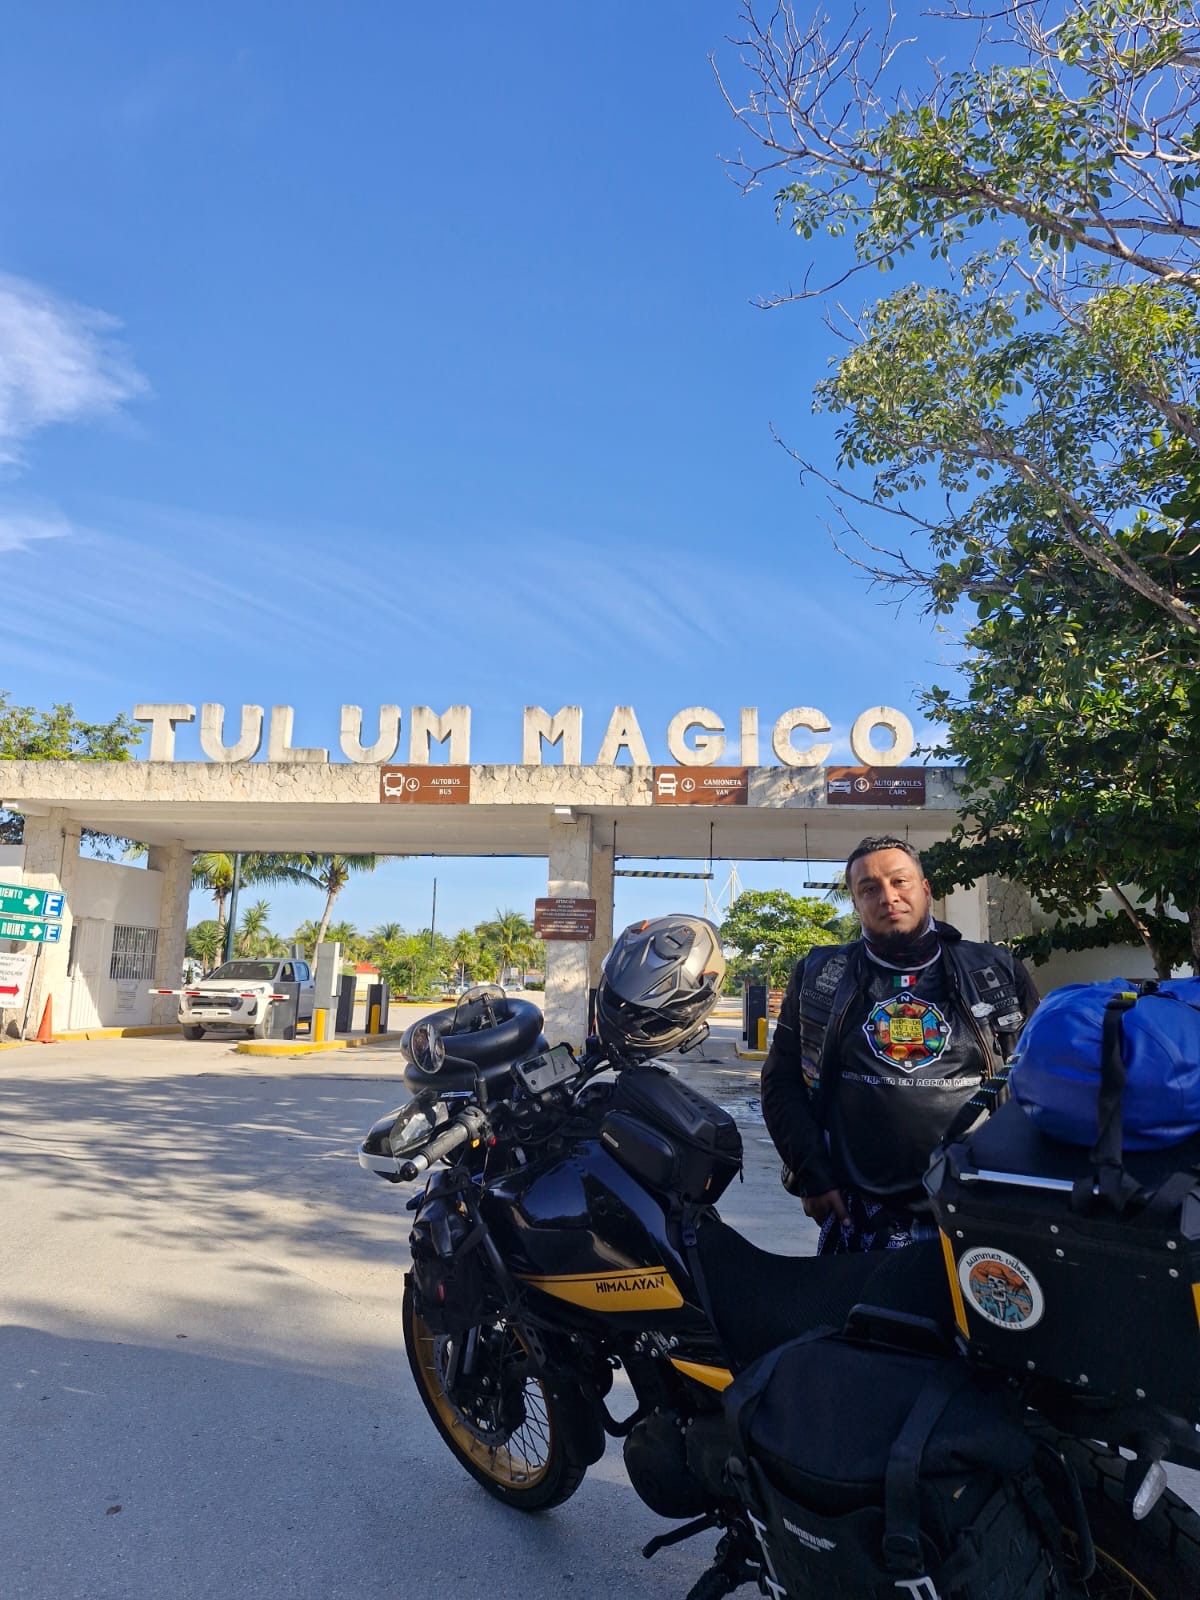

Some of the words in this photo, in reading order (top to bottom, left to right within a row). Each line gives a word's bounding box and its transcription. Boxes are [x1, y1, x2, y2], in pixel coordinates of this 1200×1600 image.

[133, 703, 472, 764] TULUM
[522, 706, 915, 767] MAGICO
[45, 893, 62, 916] E
[46, 925, 60, 940] E
[898, 1078, 914, 1086] EN
[966, 1252, 1004, 1268] summer
[1005, 1259, 1031, 1282] vibes
[595, 1276, 665, 1293] HIMALAYAN
